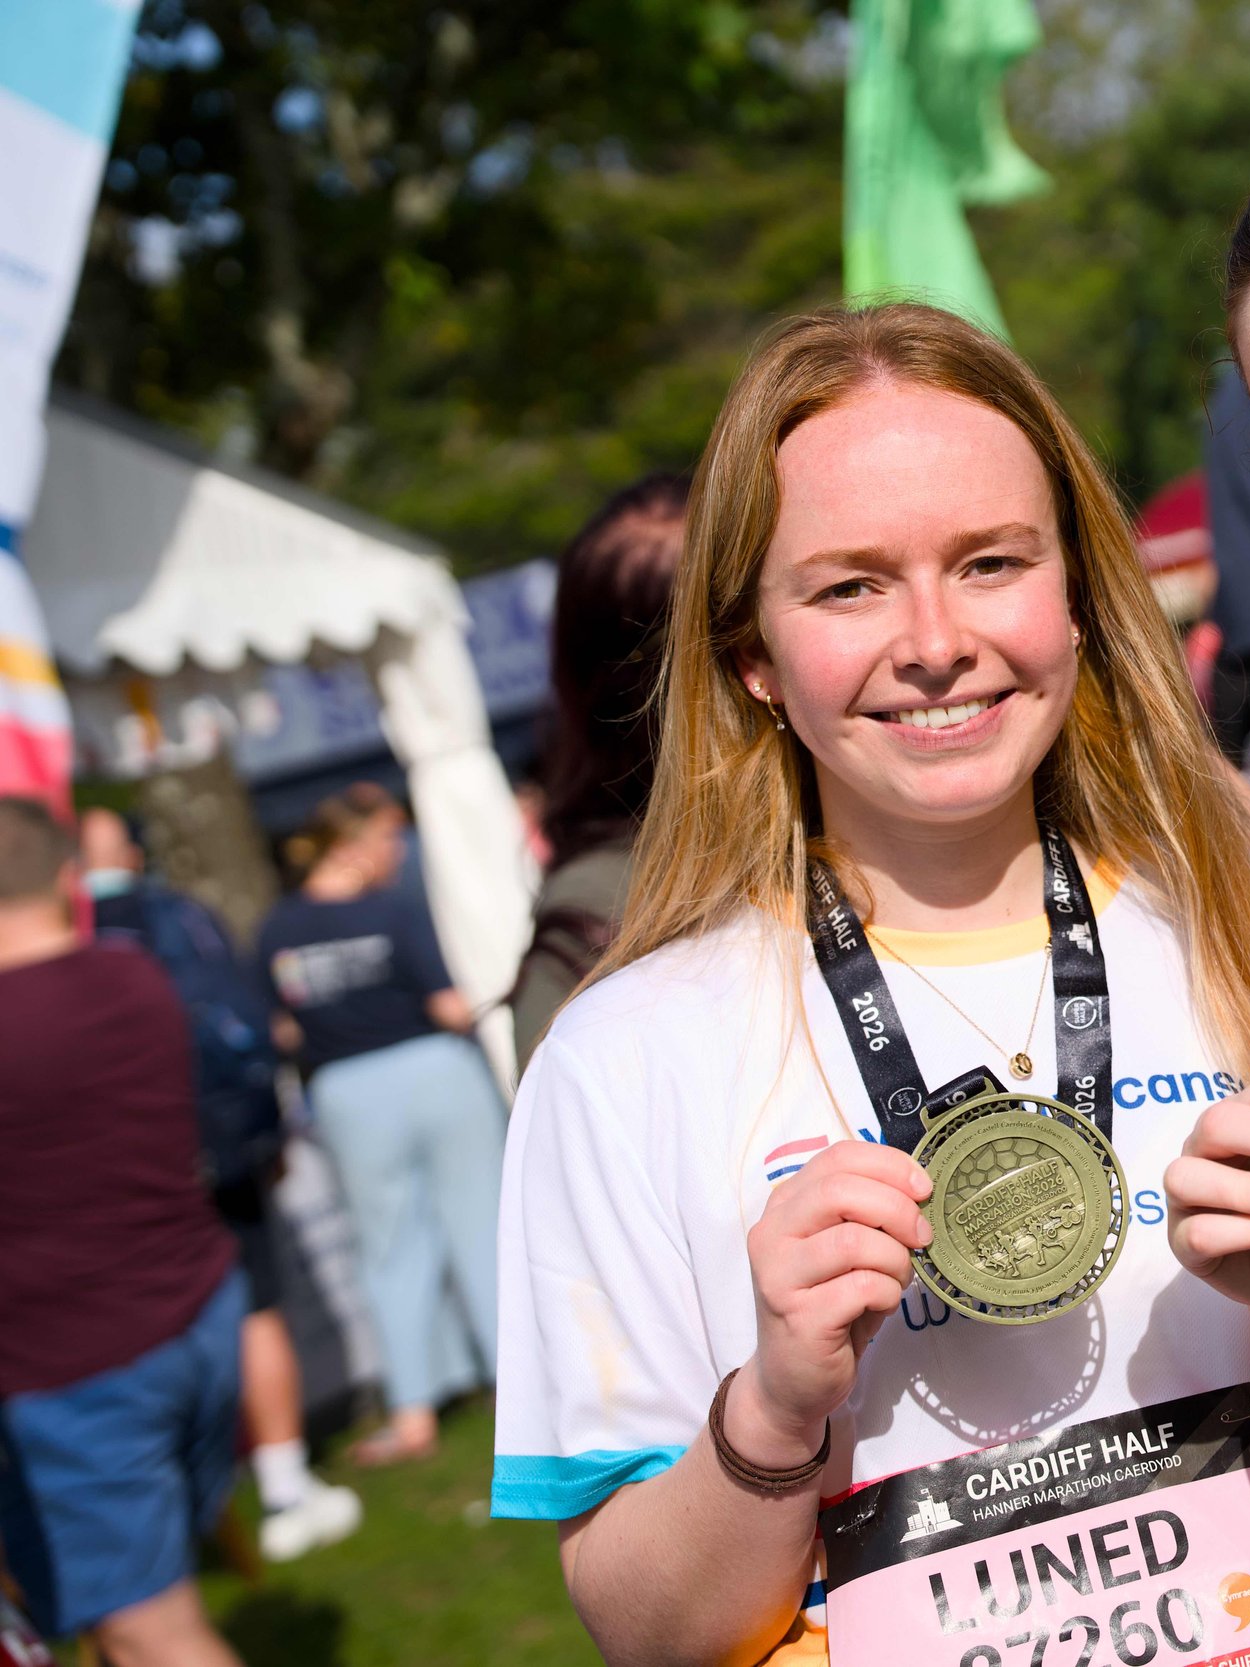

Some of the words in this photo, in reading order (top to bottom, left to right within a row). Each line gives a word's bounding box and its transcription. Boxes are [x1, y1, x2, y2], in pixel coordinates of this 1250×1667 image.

[1048, 841, 1073, 913] CARDIFF
[828, 905, 857, 950] HALF
[852, 991, 891, 1052] 2026
[957, 1185, 1016, 1225] CARDIFF
[1020, 1161, 1059, 1189] HALF
[964, 1190, 1031, 1236] MARATHON
[1033, 1175, 1064, 1195] 2026
[966, 1443, 1094, 1500] CARDIFF
[1100, 1422, 1175, 1464] HALF
[972, 1495, 1032, 1522] HANNER
[1033, 1473, 1112, 1505] MARATHON
[1114, 1454, 1182, 1483] CAERDYDD
[928, 1510, 1190, 1636] LUNED
